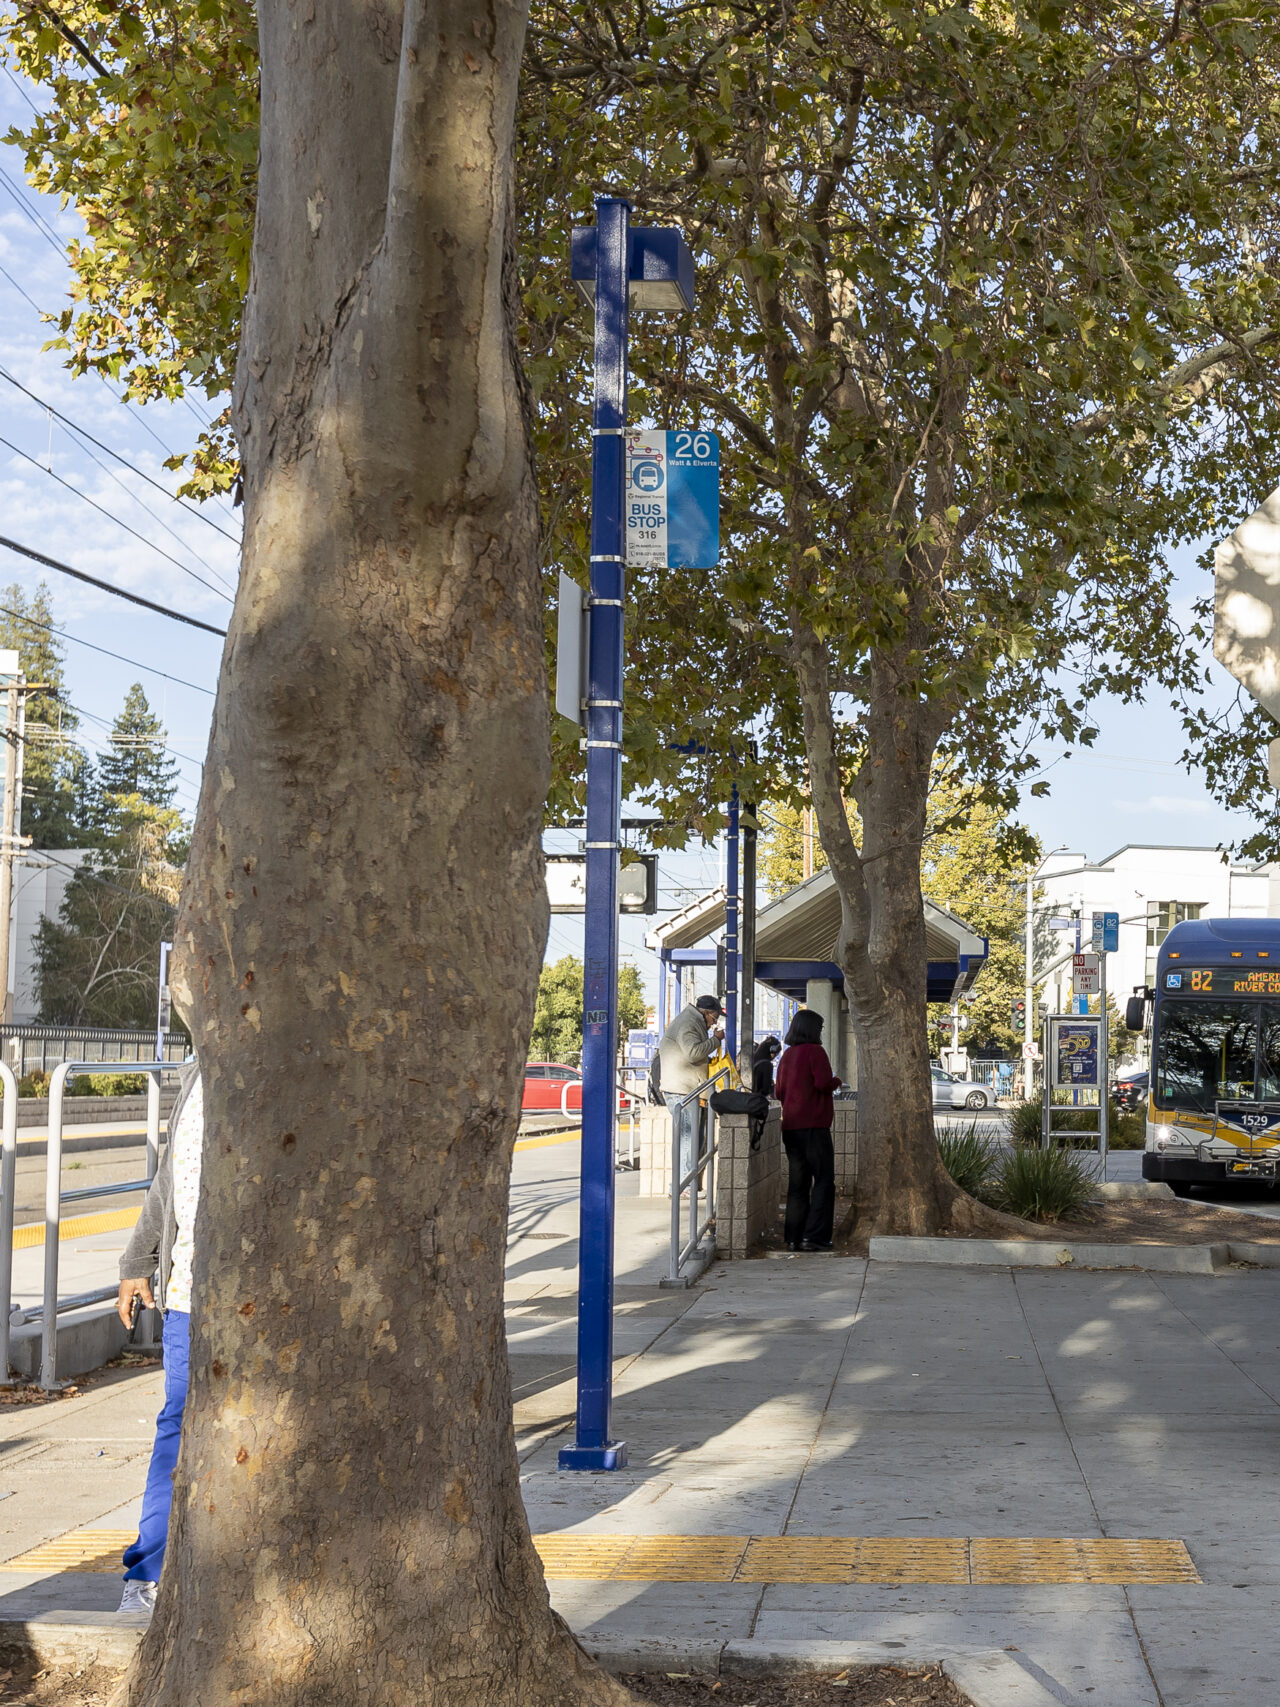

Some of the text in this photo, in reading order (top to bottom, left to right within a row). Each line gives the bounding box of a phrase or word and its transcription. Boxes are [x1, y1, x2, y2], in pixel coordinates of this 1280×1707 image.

[675, 433, 711, 458] 26
[632, 504, 661, 515] BUS
[628, 516, 666, 528] STOP
[638, 530, 657, 540] 316
[1106, 919, 1116, 927] 82
[1074, 955, 1084, 966] NO
[1074, 968, 1097, 976] PARKING
[1191, 970, 1213, 991] 82
[1234, 981, 1265, 993] RIVER
[1241, 1115, 1268, 1127] 1529
